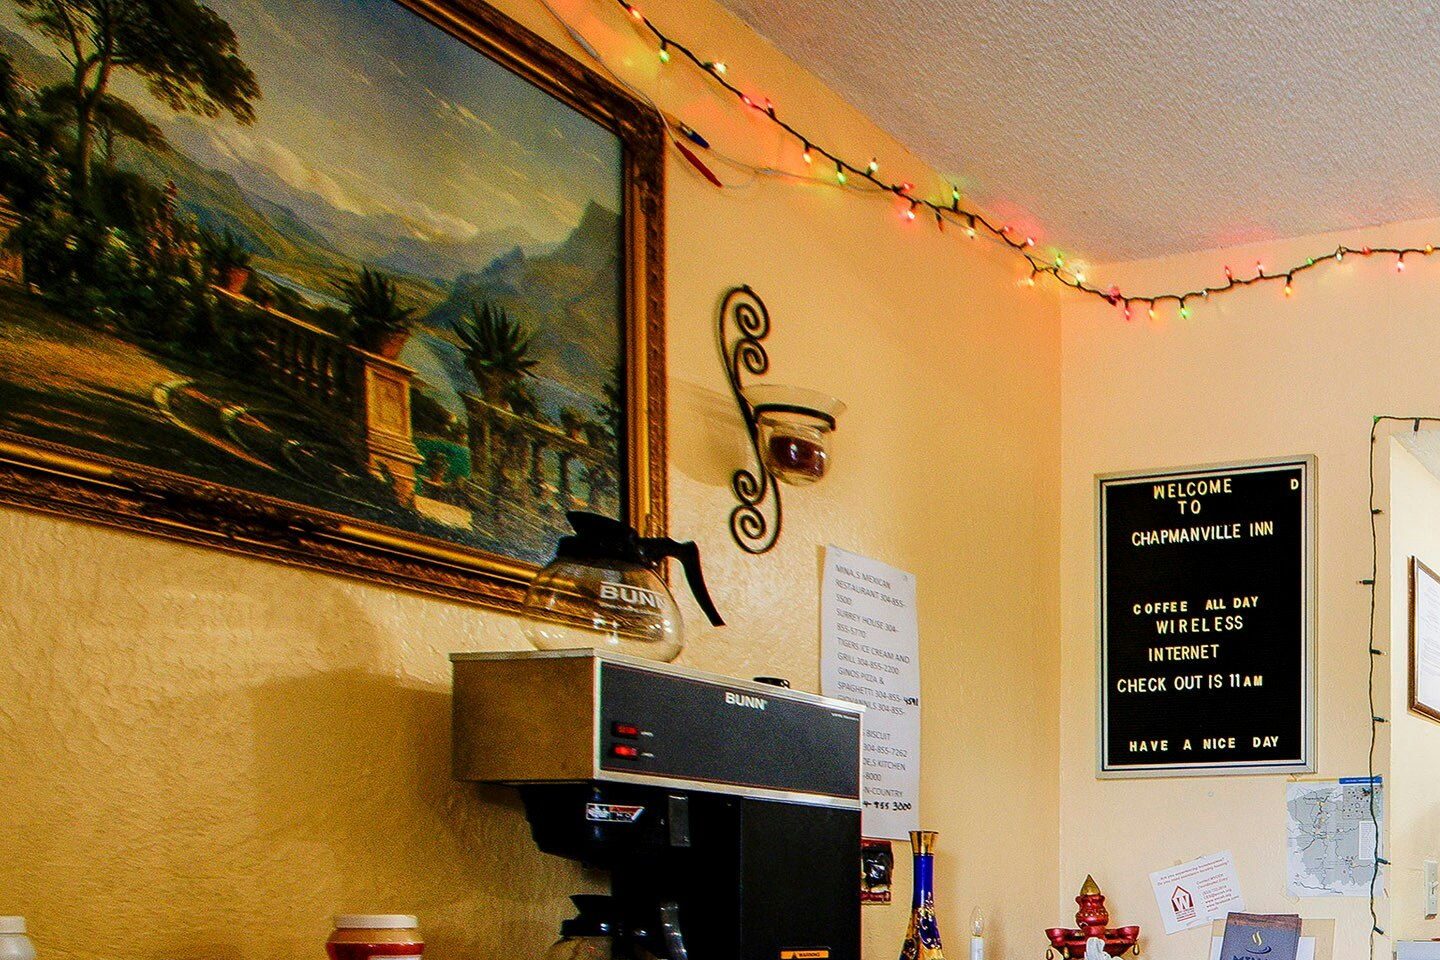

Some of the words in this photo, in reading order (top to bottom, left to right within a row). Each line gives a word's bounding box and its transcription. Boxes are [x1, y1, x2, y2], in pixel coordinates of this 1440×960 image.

[1153, 478, 1232, 499] WELCOME
[1290, 478, 1299, 490] D
[1178, 499, 1201, 515] TO
[1132, 523, 1241, 546] CHAPMANVILLE
[1249, 520, 1274, 538] INN
[836, 579, 880, 599] RESTAURANT
[862, 573, 891, 590] MEXICAN
[1133, 600, 1188, 615] COFFEE
[1205, 598, 1226, 611] ALL
[1233, 596, 1258, 609] DAY
[836, 608, 860, 621] SURREY
[862, 616, 884, 630] HOUSE
[1156, 616, 1243, 634] WIRELESS
[837, 637, 860, 650] TIGERS
[861, 644, 870, 654] ICE
[871, 647, 894, 660] CREAM
[895, 653, 911, 664] AND
[837, 652, 856, 664] GRILL
[1148, 643, 1220, 662] INTERNET
[861, 672, 878, 683] PIZZA
[880, 677, 885, 685] &
[1117, 676, 1166, 693] CHECK
[1174, 674, 1202, 690] OUT
[1208, 674, 1223, 689] IS
[838, 682, 874, 697] SPAGHETTI
[725, 691, 765, 710] BUNN
[866, 729, 891, 741] BISCUIT
[1129, 739, 1168, 752] HAVE
[1183, 738, 1192, 750] A
[1203, 736, 1236, 750] NICE
[1253, 735, 1279, 748] DAY
[878, 760, 906, 771] KITCHEN
